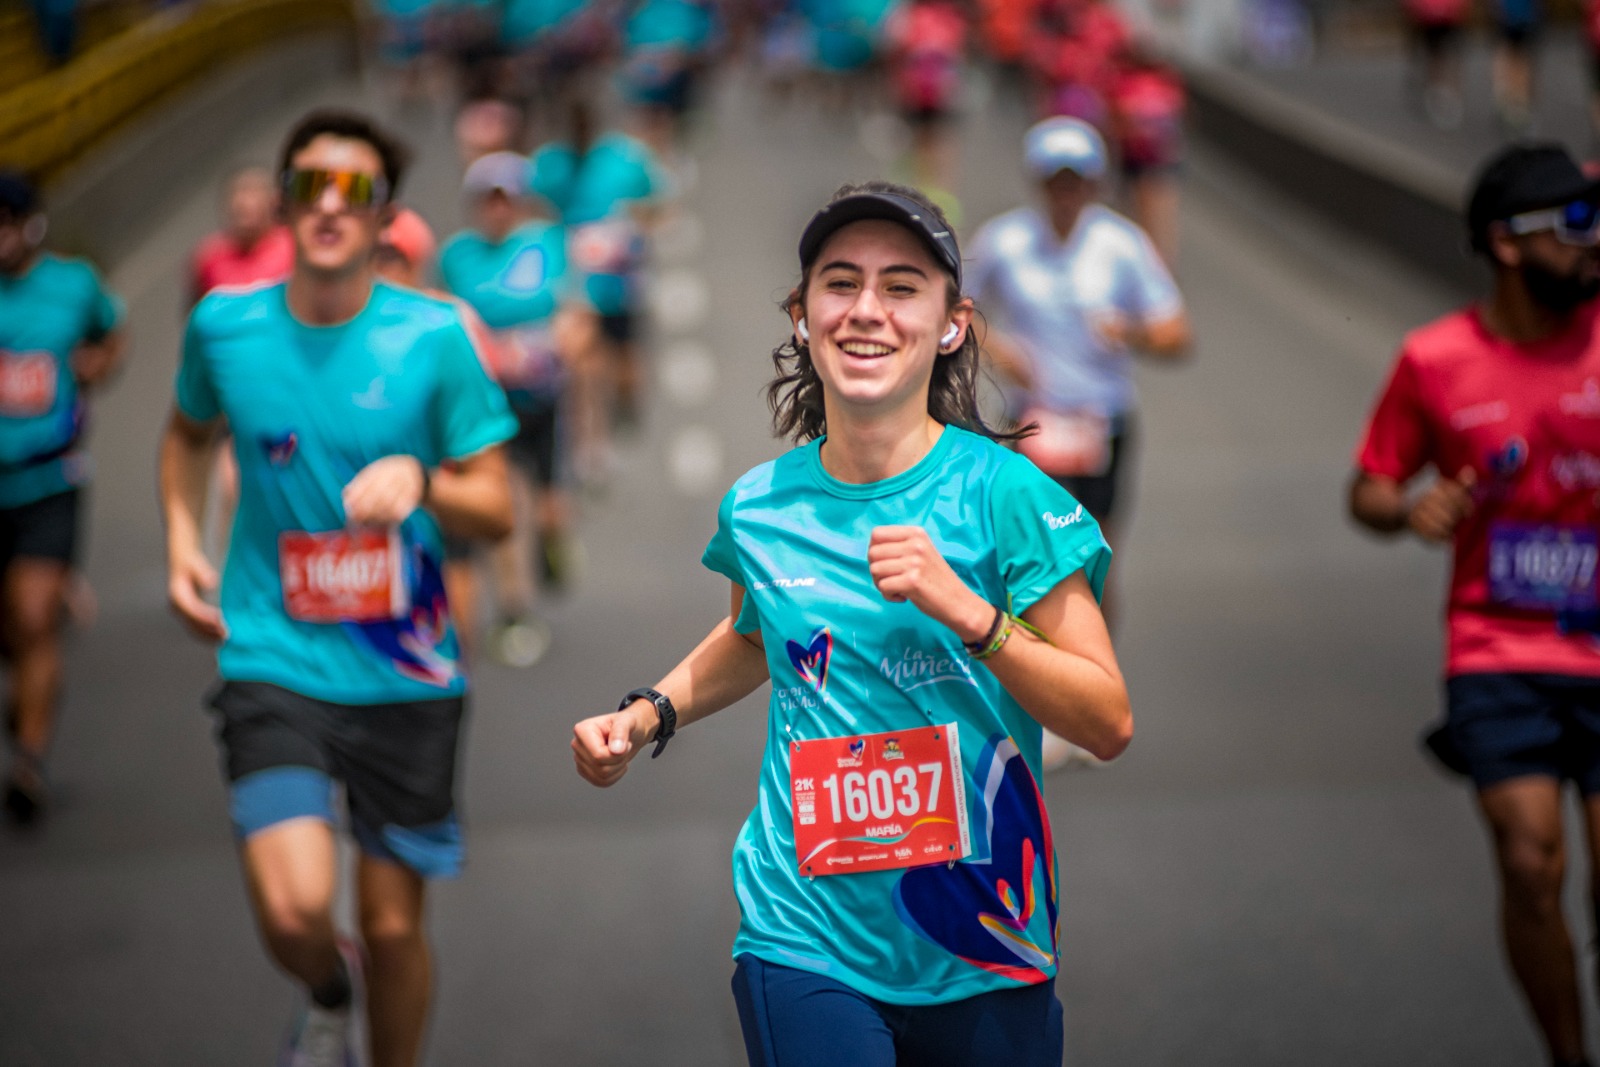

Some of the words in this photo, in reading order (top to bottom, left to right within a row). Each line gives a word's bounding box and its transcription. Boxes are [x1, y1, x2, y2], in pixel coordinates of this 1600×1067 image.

[794, 778, 815, 791] 21K
[823, 762, 943, 824] 16037
[865, 823, 903, 837] MARÍA
